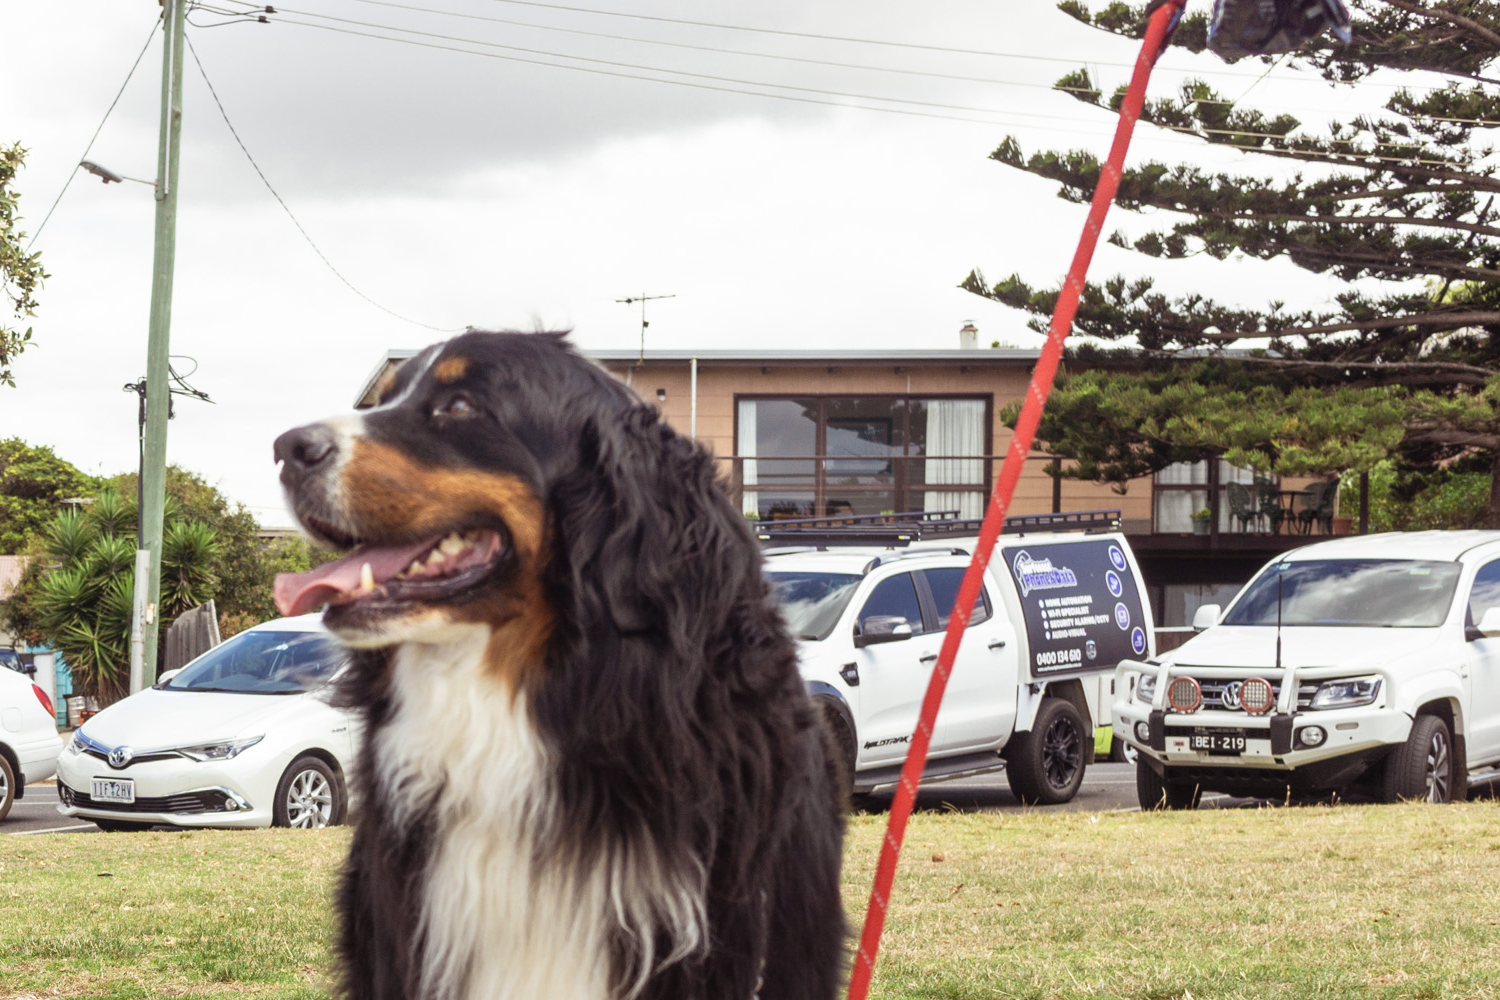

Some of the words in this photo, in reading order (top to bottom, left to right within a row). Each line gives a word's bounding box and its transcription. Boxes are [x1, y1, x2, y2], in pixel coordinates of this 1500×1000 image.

[1045, 598, 1061, 607] HOME
[1061, 595, 1093, 606] AUTOMATION
[1061, 606, 1089, 616] SPECIALIST
[1050, 619, 1074, 629] SECURITY
[1037, 652, 1056, 666] 0400
[1057, 650, 1068, 663] 134
[1069, 648, 1081, 661] 610
